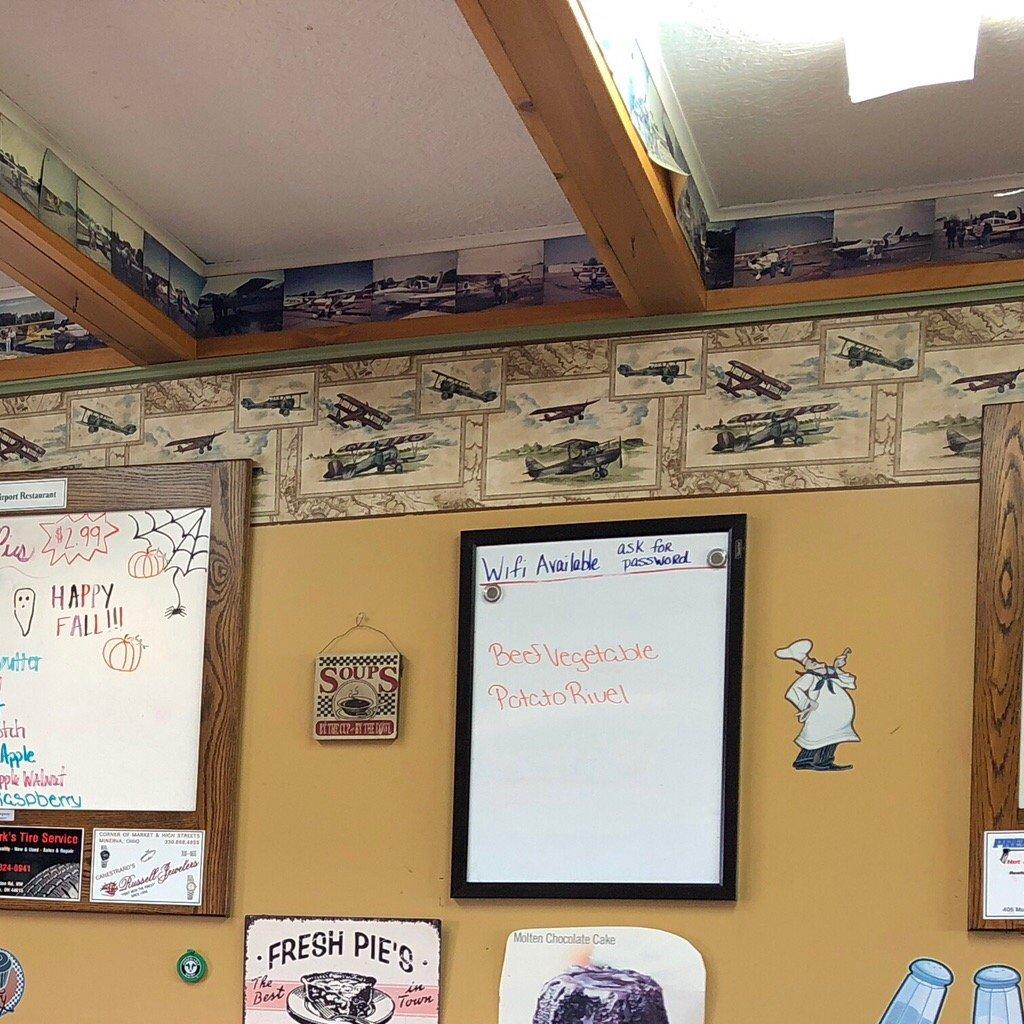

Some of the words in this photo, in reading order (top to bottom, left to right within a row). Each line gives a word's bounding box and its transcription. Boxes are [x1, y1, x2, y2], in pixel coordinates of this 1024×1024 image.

[20, 491, 57, 500] Restaurant
[55, 525, 101, 550] $2.99
[617, 541, 646, 555] ask
[650, 538, 673, 554] for
[482, 555, 527, 582] Wifi
[536, 549, 600, 576] Available
[51, 583, 114, 610] HAPPY
[542, 643, 659, 673] Vegetable
[319, 666, 401, 695] SOUPS
[488, 684, 566, 711] Potato
[0, 743, 36, 768] Apple
[20, 832, 39, 843] Tire
[42, 832, 78, 844] Service
[118, 866, 159, 892] Russell
[157, 859, 199, 885] Jewelers
[513, 932, 544, 943] Molten
[545, 932, 591, 945] Chocolate
[592, 933, 616, 945] Cake
[268, 930, 344, 970] FRESH
[354, 931, 414, 973] PIE'S
[251, 974, 273, 988] The
[405, 980, 425, 994] in
[253, 985, 286, 1006] Best
[398, 993, 434, 1008] Town
